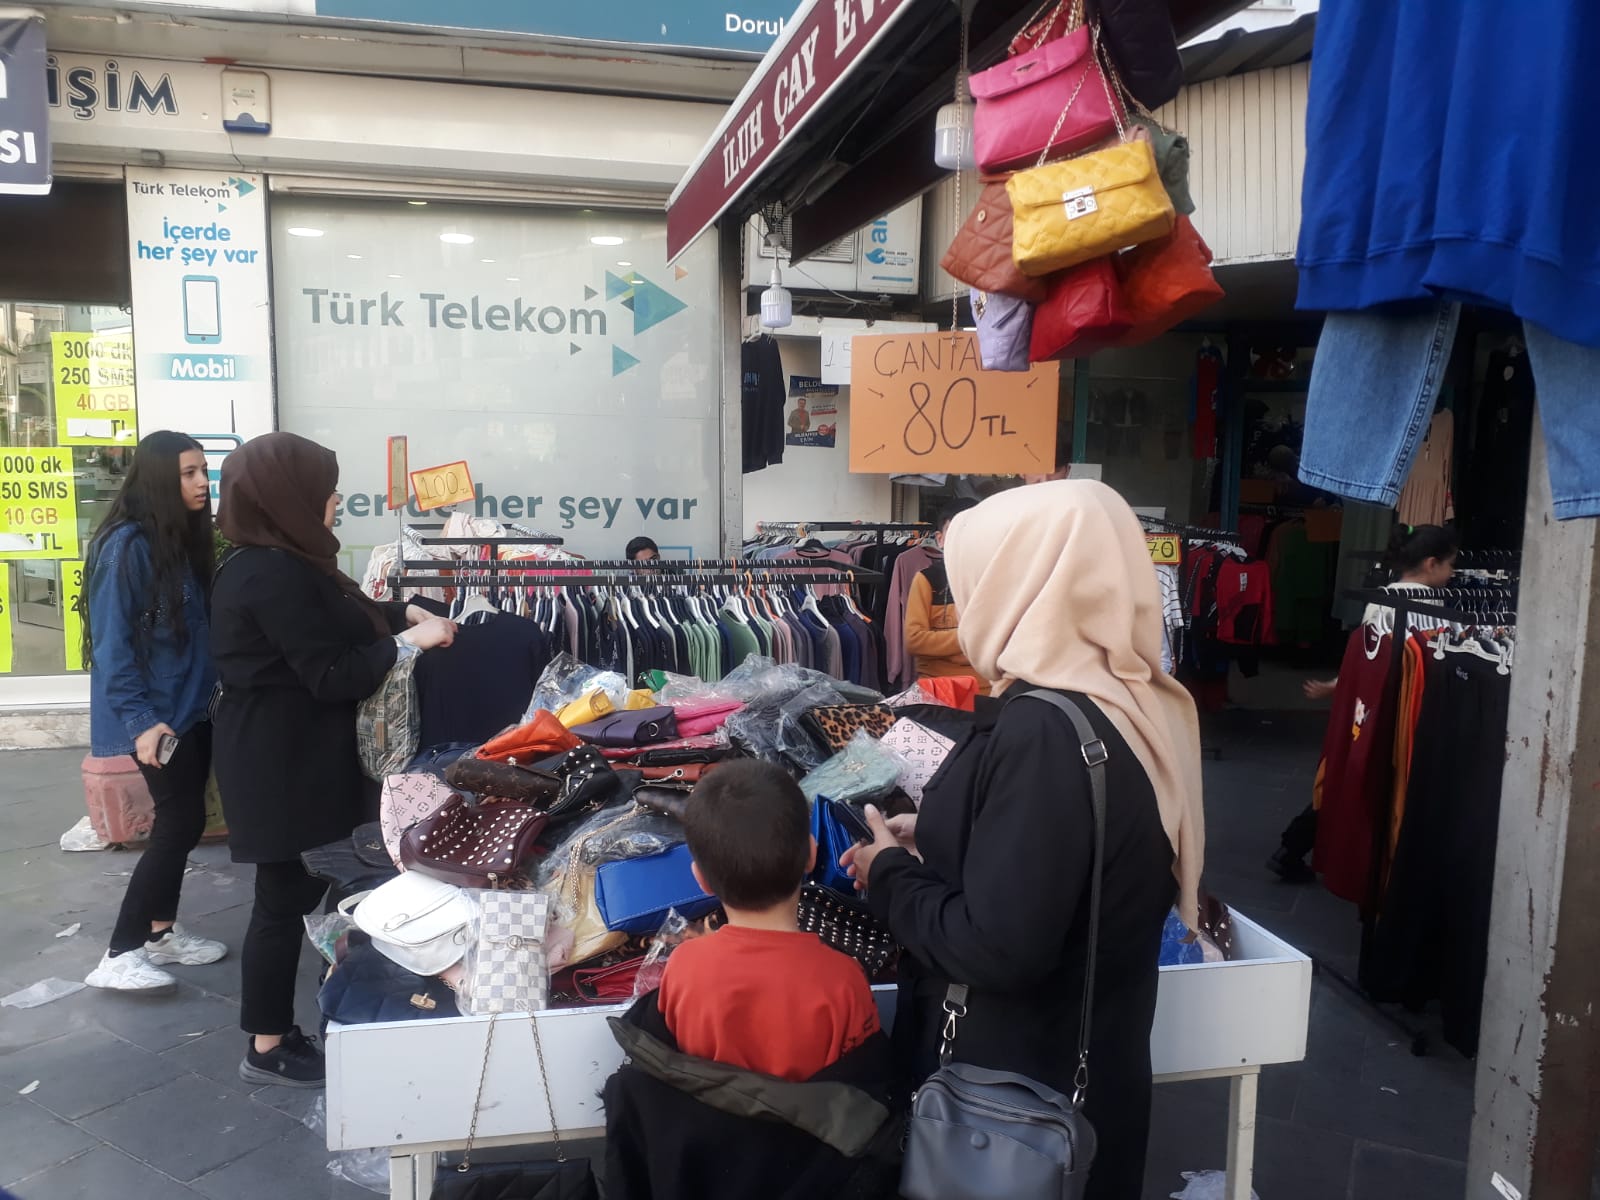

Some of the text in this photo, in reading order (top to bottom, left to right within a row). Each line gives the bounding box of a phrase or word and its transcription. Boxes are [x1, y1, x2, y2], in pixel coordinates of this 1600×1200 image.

[723, 100, 765, 189] İLUH
[773, 24, 820, 140] ÇAY
[132, 181, 231, 199] Türk Telekom
[137, 240, 258, 266] her şey var
[302, 287, 607, 336] Türk Telekom
[63, 340, 104, 359] 3000
[874, 335, 983, 378] ÇANTA
[60, 367, 91, 385] 250
[171, 358, 235, 379] Mobil
[799, 380, 824, 388] BELD
[76, 393, 130, 411] 40 GB
[904, 377, 1017, 456] 80 TL
[0, 456, 62, 474] 000 dk
[0, 481, 68, 499] 50 SMS
[475, 482, 544, 518] her
[558, 494, 623, 529] şey
[636, 497, 698, 521] var
[5, 507, 58, 525] 10 GB
[41, 533, 63, 550] TL
